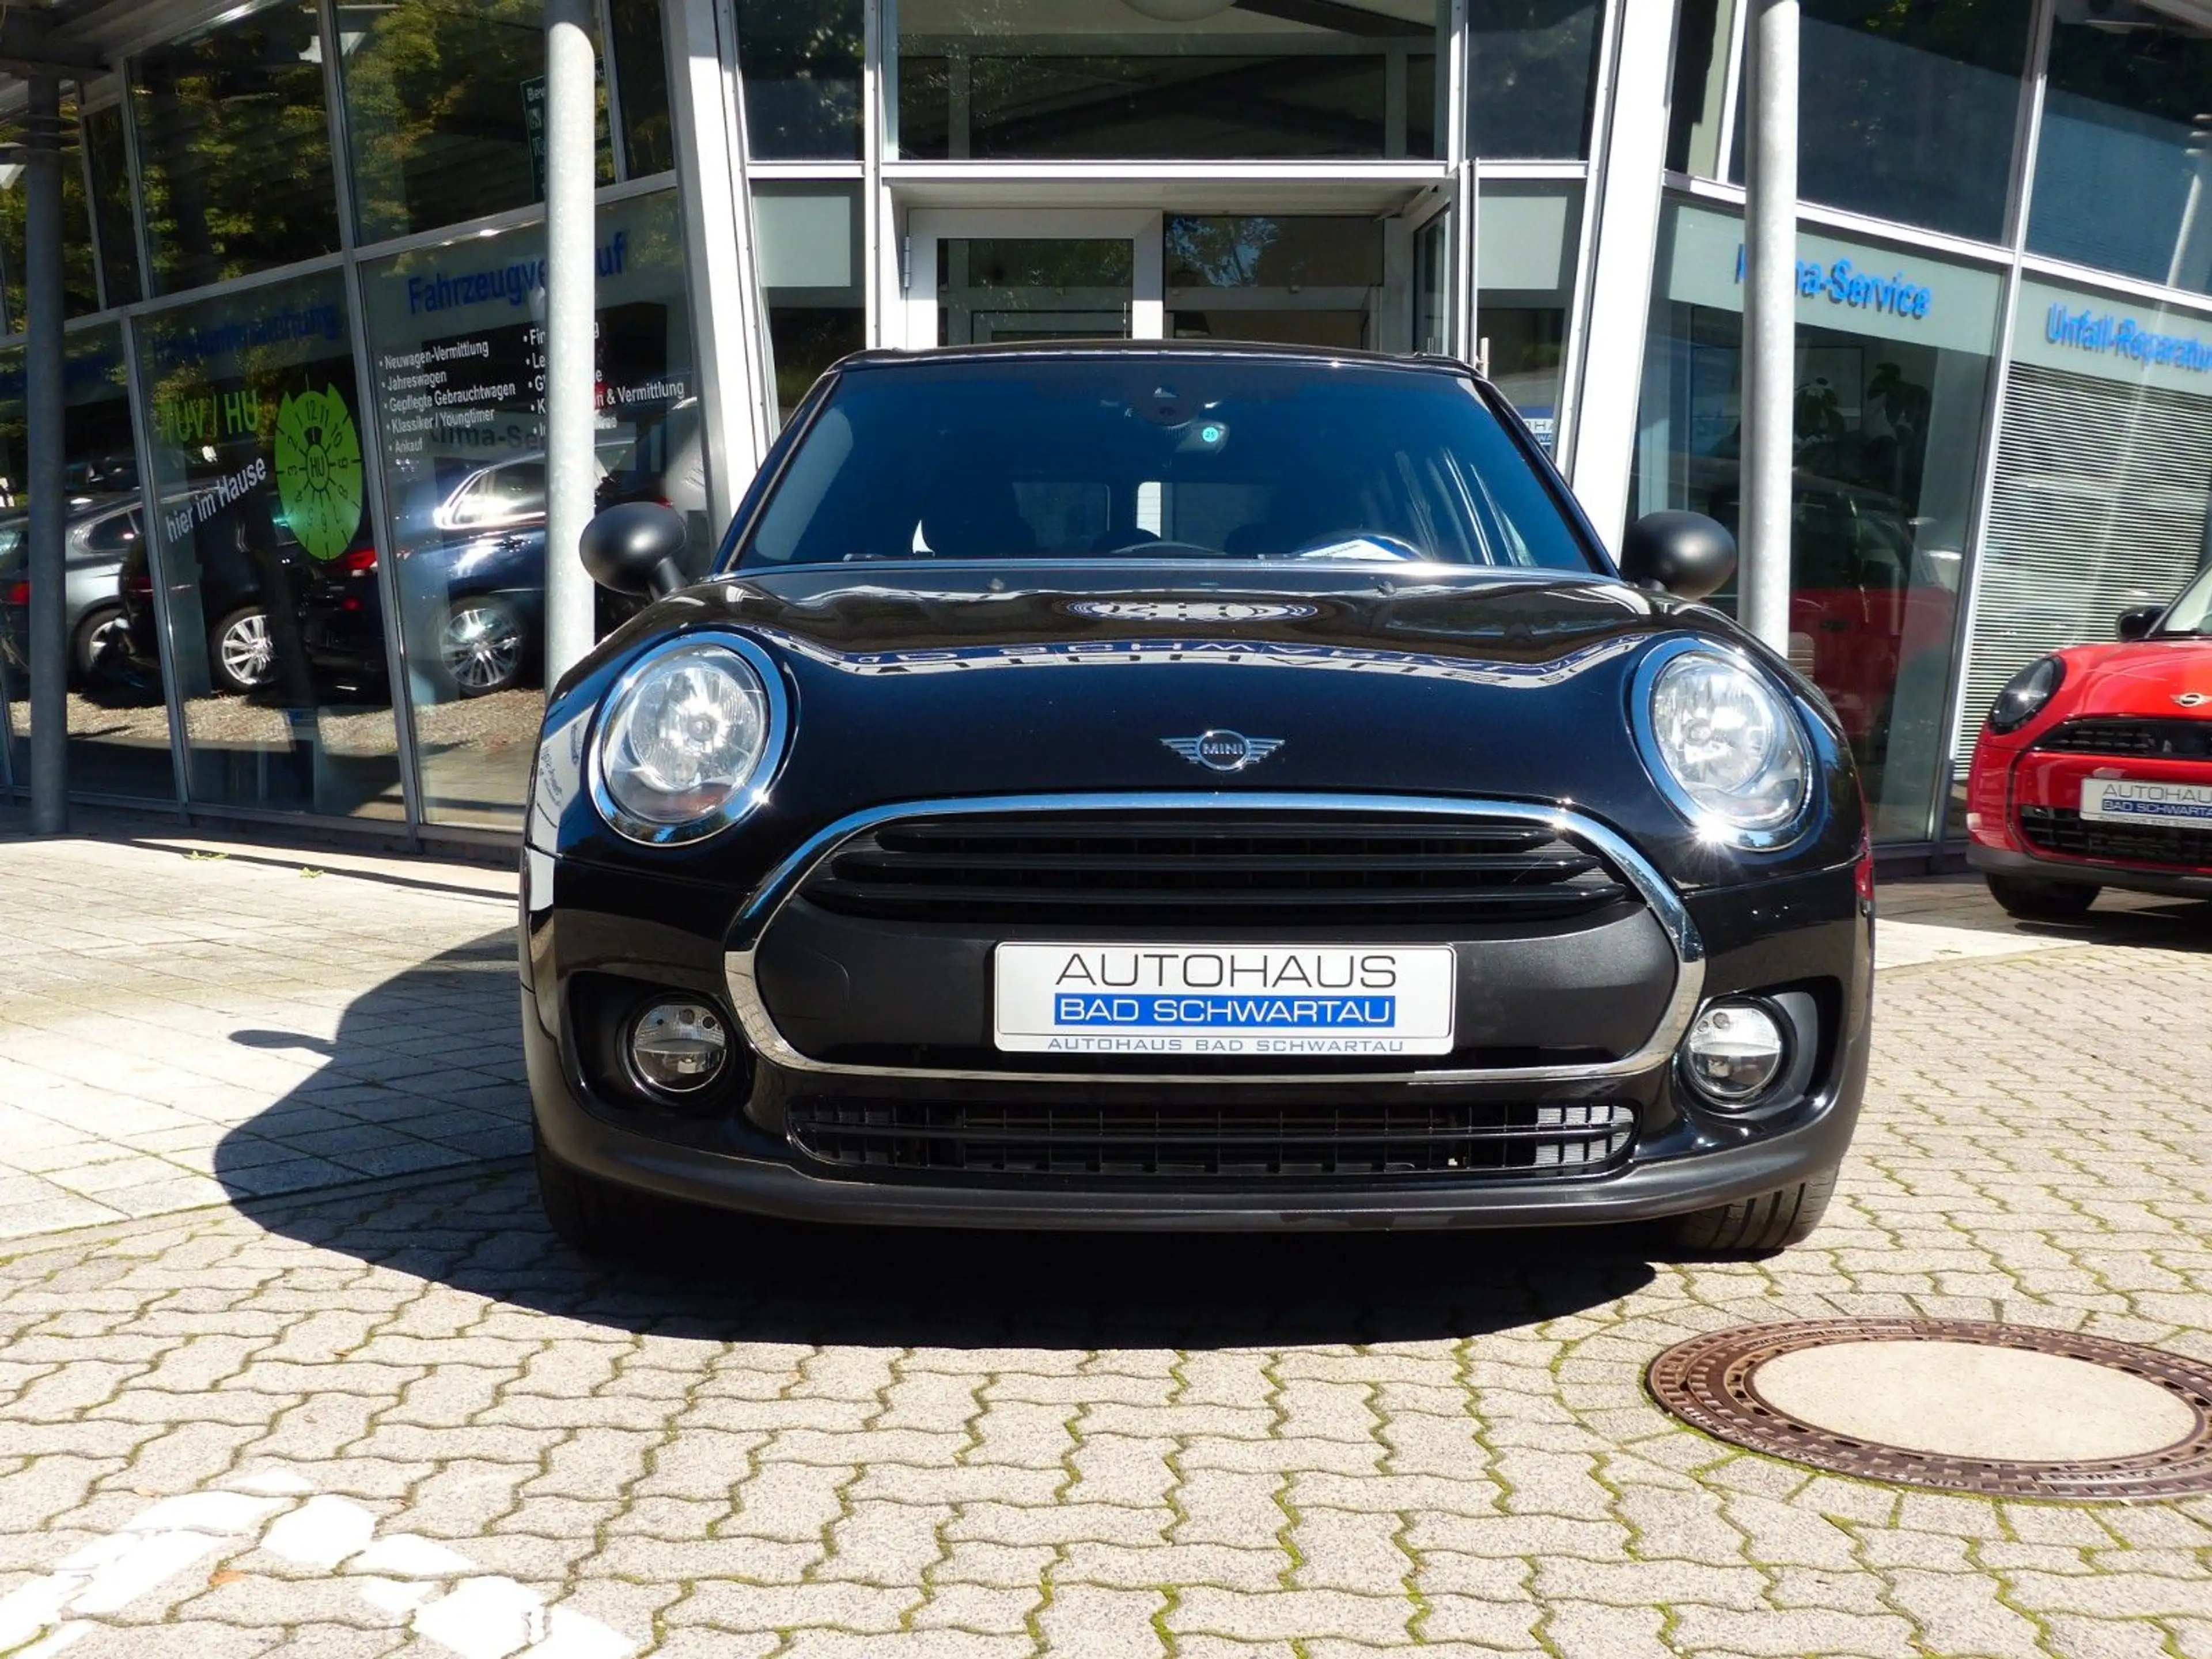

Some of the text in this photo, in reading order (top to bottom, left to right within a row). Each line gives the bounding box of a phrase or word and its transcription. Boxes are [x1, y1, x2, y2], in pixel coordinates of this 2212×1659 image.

[385, 340, 489, 370] Neuwagen-Vermittlung
[387, 371, 447, 391] Jahreswagen
[389, 394, 433, 414] Gepflegte
[434, 382, 517, 406] Gebrauchtwagen
[607, 388, 616, 405] &
[617, 381, 685, 404] Vermittlung
[224, 389, 259, 434] HU
[307, 400, 317, 421] 12
[391, 415, 433, 434] Klassiker
[440, 408, 496, 428] Youngtimer
[395, 437, 423, 453] Ankauf
[287, 465, 297, 476] 3
[309, 456, 325, 478] HU
[166, 457, 267, 542] hier im Hause
[1202, 743, 1244, 755] MINI
[2104, 800, 2133, 811] BAD
[1055, 953, 1397, 988] AUTOHAUS
[1060, 999, 1391, 1023] BAD SCHWARTAU
[1047, 1038, 1404, 1052] AUTOHAUS BAD SCHWARTAU
